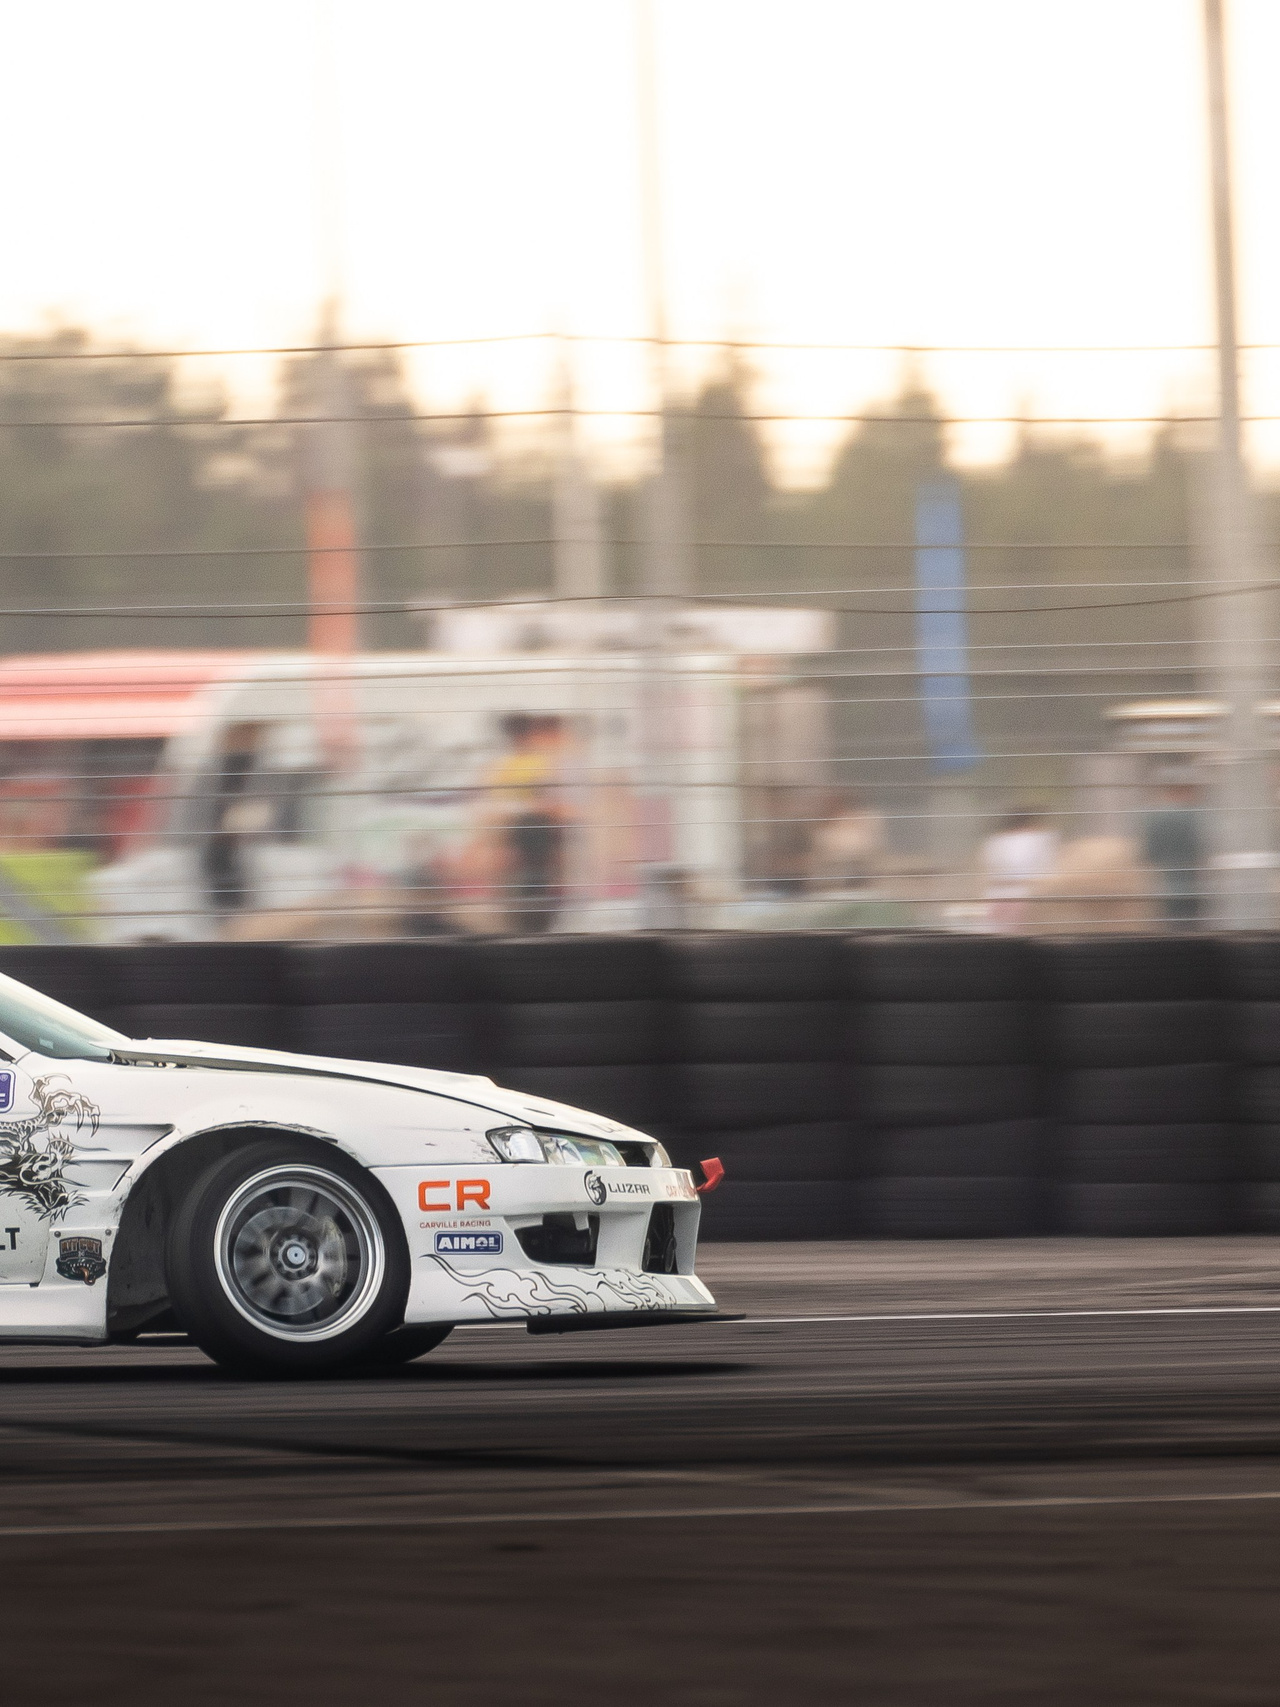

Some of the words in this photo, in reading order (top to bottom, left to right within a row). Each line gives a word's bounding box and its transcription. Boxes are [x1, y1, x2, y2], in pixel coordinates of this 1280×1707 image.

[608, 1183, 651, 1195] LUZAR
[418, 1179, 490, 1212] CR
[420, 1221, 458, 1229] CARVILLE
[460, 1220, 491, 1228] RACING
